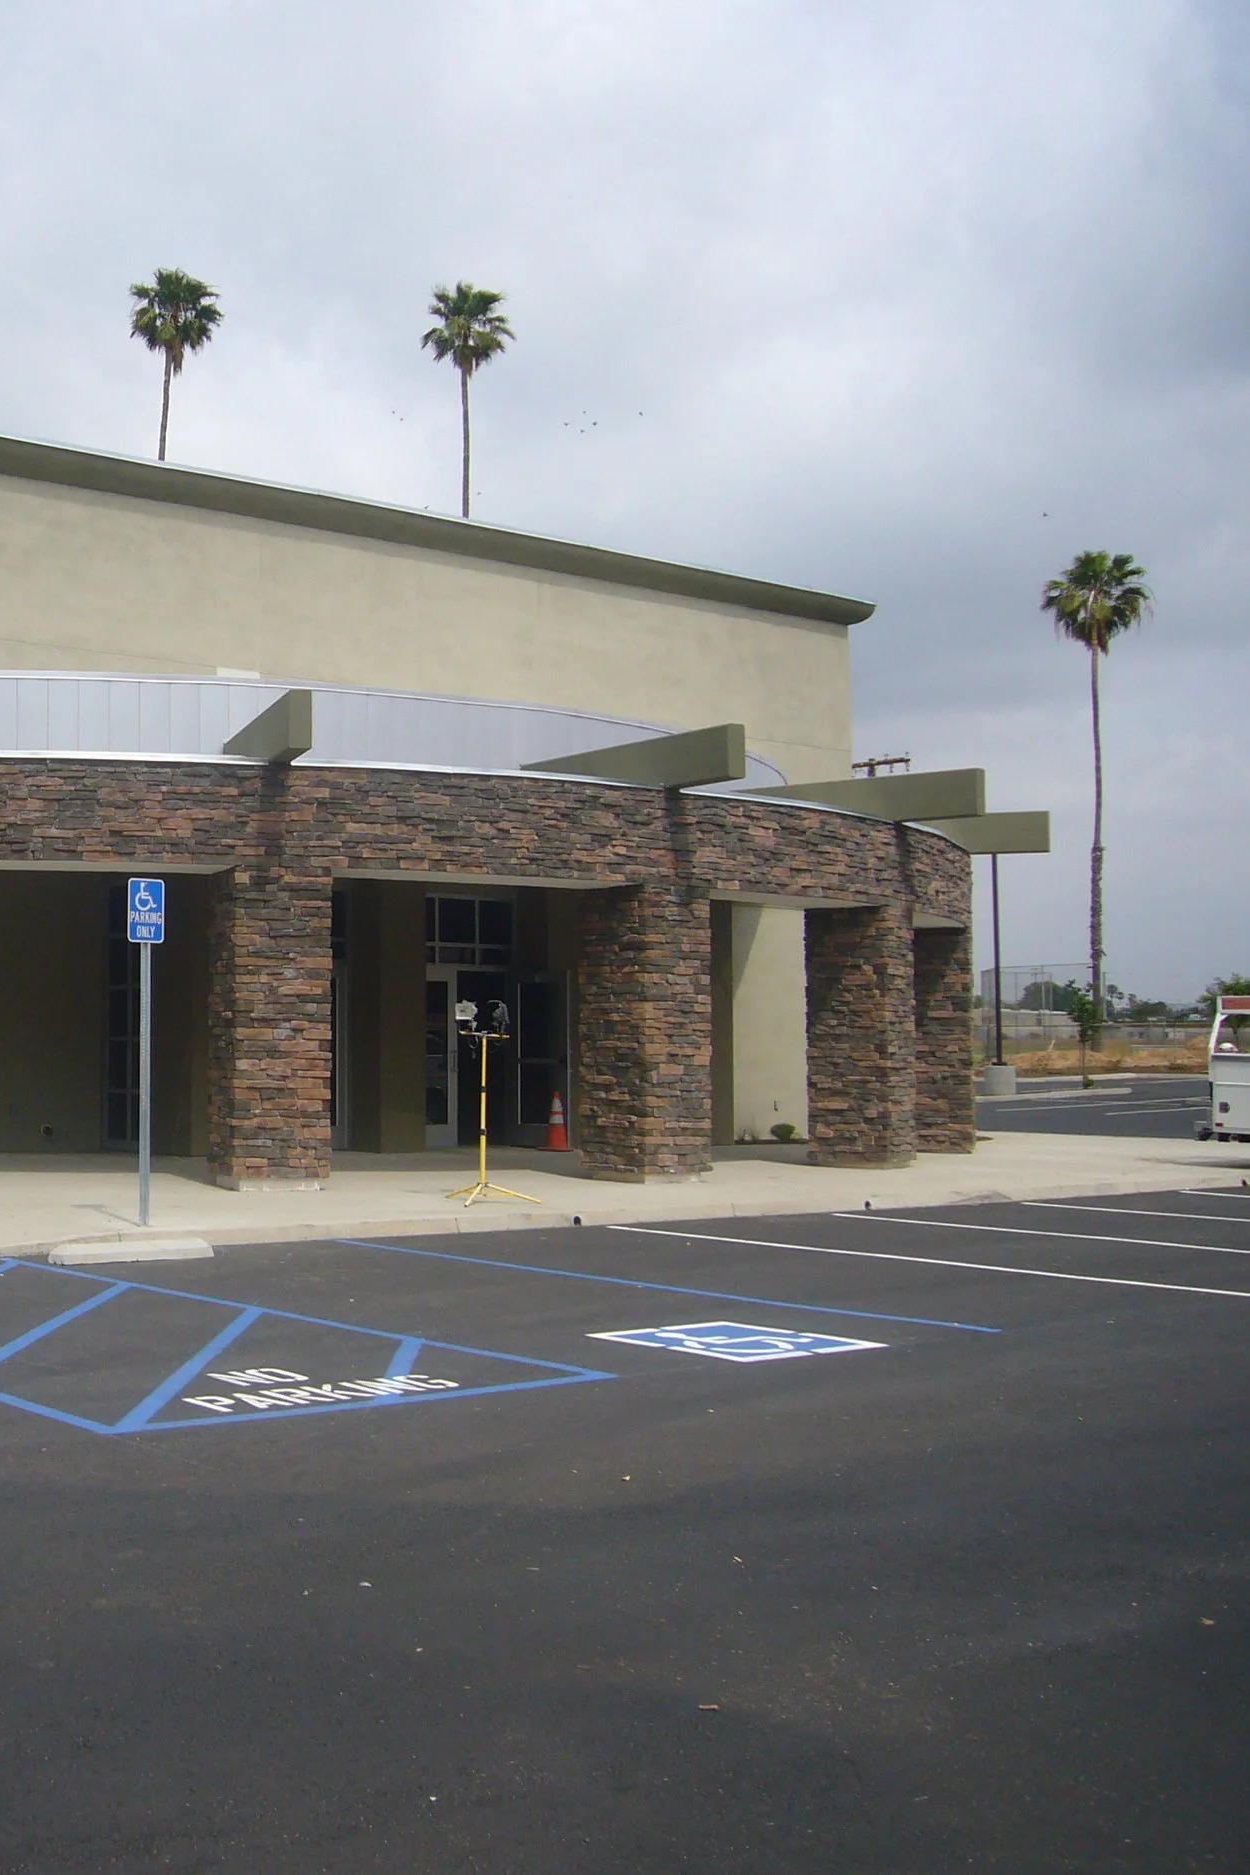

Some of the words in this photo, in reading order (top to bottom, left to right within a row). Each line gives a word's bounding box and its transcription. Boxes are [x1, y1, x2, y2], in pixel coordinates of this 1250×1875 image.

[130, 911, 162, 924] PARKING
[136, 925, 156, 938] ONLY
[206, 1367, 310, 1387] NO
[181, 1373, 461, 1413] PARKING
